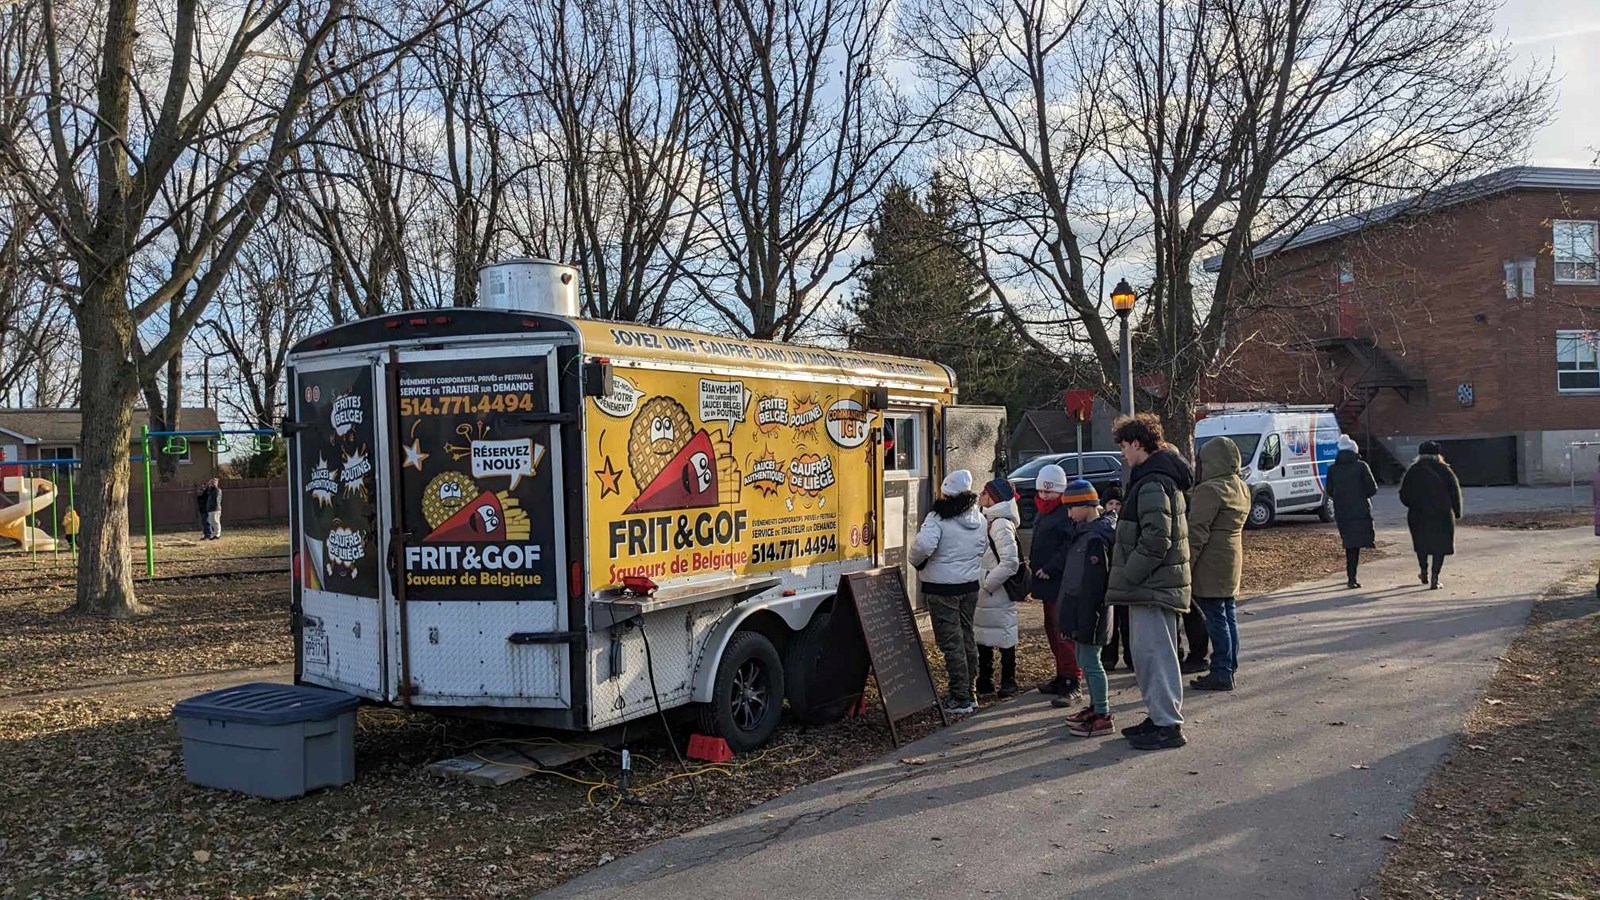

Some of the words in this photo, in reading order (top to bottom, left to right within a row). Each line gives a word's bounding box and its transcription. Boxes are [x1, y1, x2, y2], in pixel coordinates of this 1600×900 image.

[610, 329, 662, 349] SOYEZ
[662, 335, 697, 352] UNE
[698, 340, 753, 359] GAUFRE
[753, 346, 787, 362] DANS
[787, 350, 806, 364] UN
[807, 352, 845, 367] MONDE
[504, 373, 533, 381] FESTIVALS
[400, 386, 431, 396] SERVICE
[441, 384, 480, 394] TRAITEUR
[493, 382, 534, 392] DEMANDE
[701, 382, 741, 395] ESSAYEZ-MOI
[335, 395, 361, 412] FRITES
[400, 392, 534, 416] 514.771.4494
[702, 401, 722, 409] SAUCES
[723, 401, 742, 410] BELGES
[759, 398, 788, 412] FRITES
[334, 410, 363, 425] BELGES
[717, 409, 741, 420] POUTINE
[758, 409, 789, 426] BELGES
[789, 404, 823, 428] POUTINES
[841, 420, 857, 438] ICI
[473, 445, 530, 457] RÉSERVEZ
[340, 458, 372, 482] POUTINES
[483, 459, 520, 471] NOUS
[753, 460, 776, 472] SAUCES
[789, 454, 832, 476] GAUFRES
[311, 468, 329, 480] SAUCES
[744, 470, 786, 486] AUTHENTIQUES
[791, 475, 803, 487] DE
[803, 471, 836, 491] LIÈGE
[329, 530, 361, 547] GAUFRES
[609, 509, 748, 559] FRIT&GOF
[752, 528, 774, 539] SERVICE
[781, 524, 806, 536] TRAITEUR
[813, 521, 837, 531] DEMANDE
[339, 543, 365, 561] LIÈGE
[405, 544, 541, 570] FRIT&GOF
[752, 533, 837, 564] 514.771.4494
[609, 561, 666, 585] Saveurs
[670, 555, 688, 574] de
[692, 550, 748, 571] Belgique
[406, 571, 457, 586] Saveurs
[460, 572, 477, 585] de
[480, 571, 542, 587] Belgique
